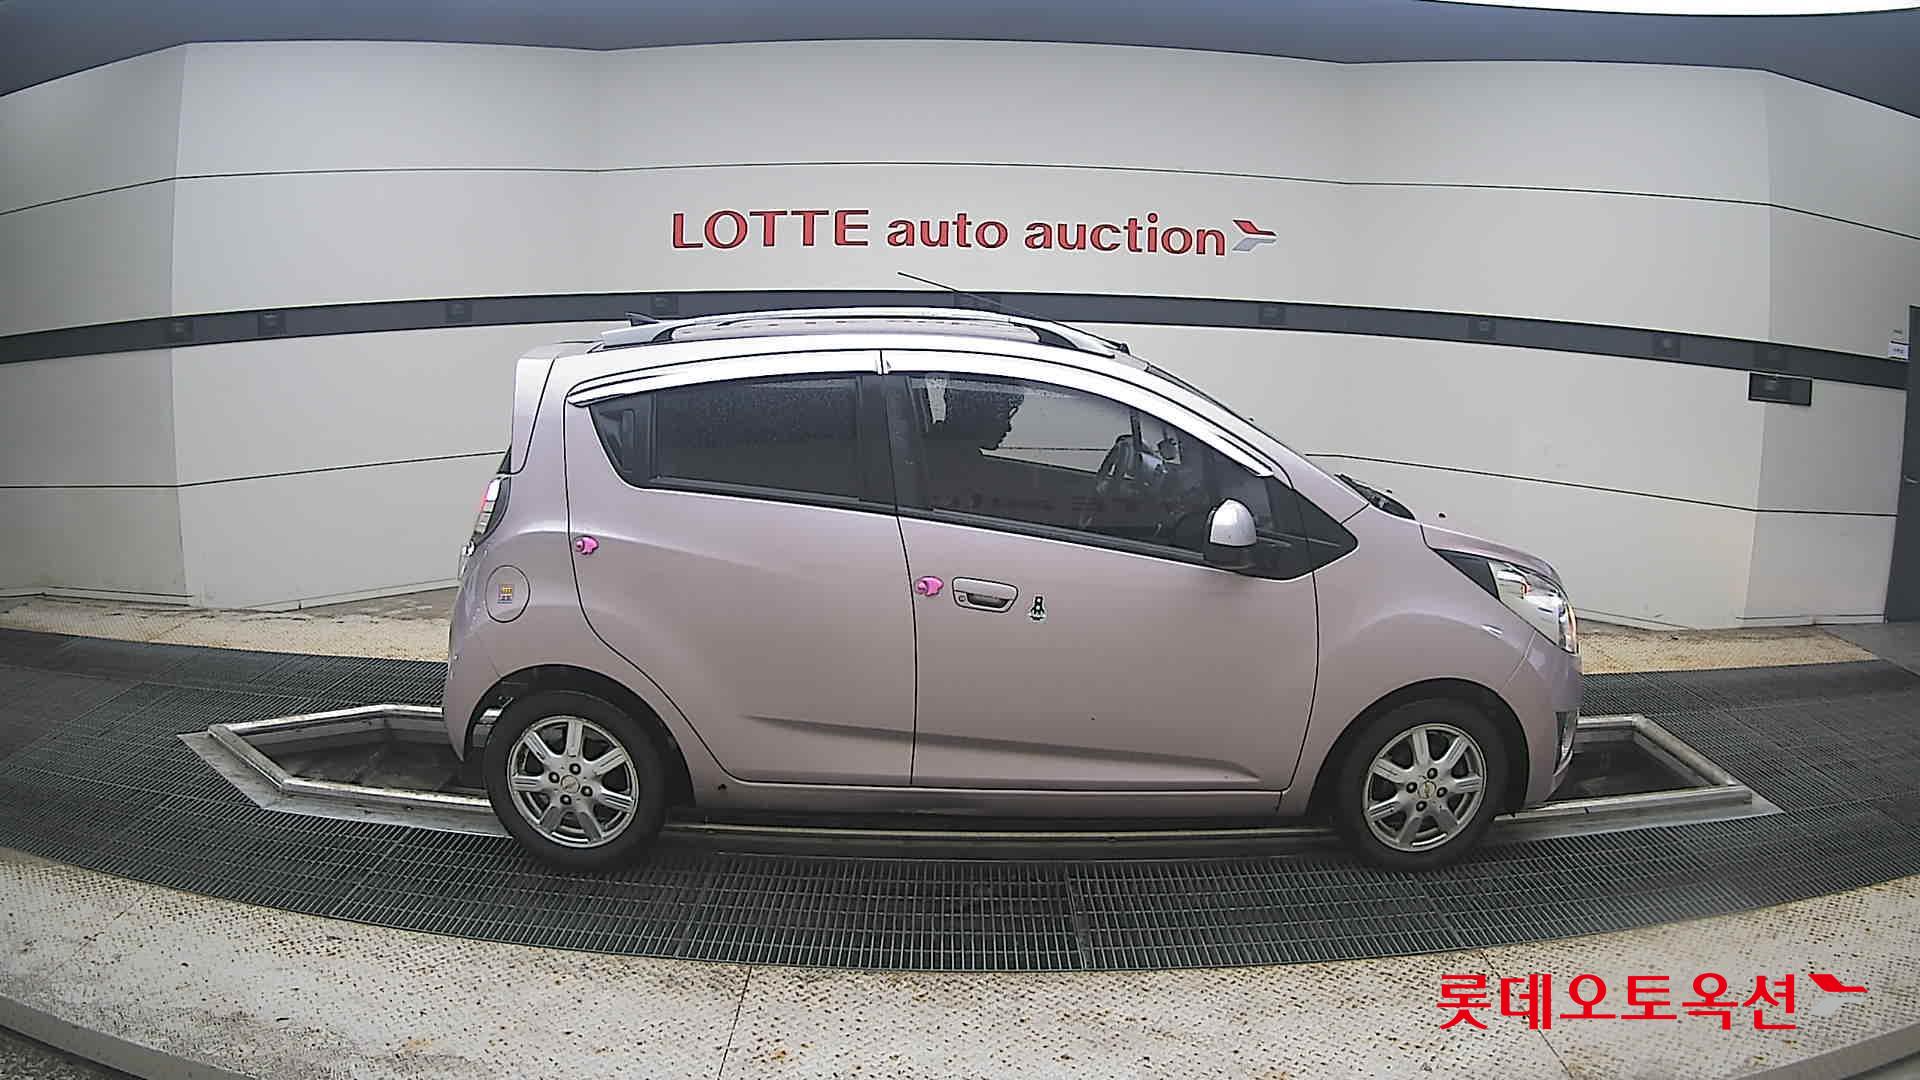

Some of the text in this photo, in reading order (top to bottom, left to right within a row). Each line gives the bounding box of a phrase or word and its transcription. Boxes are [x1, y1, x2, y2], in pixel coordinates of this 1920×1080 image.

[672, 209, 1227, 257] LOTTE auto auction
